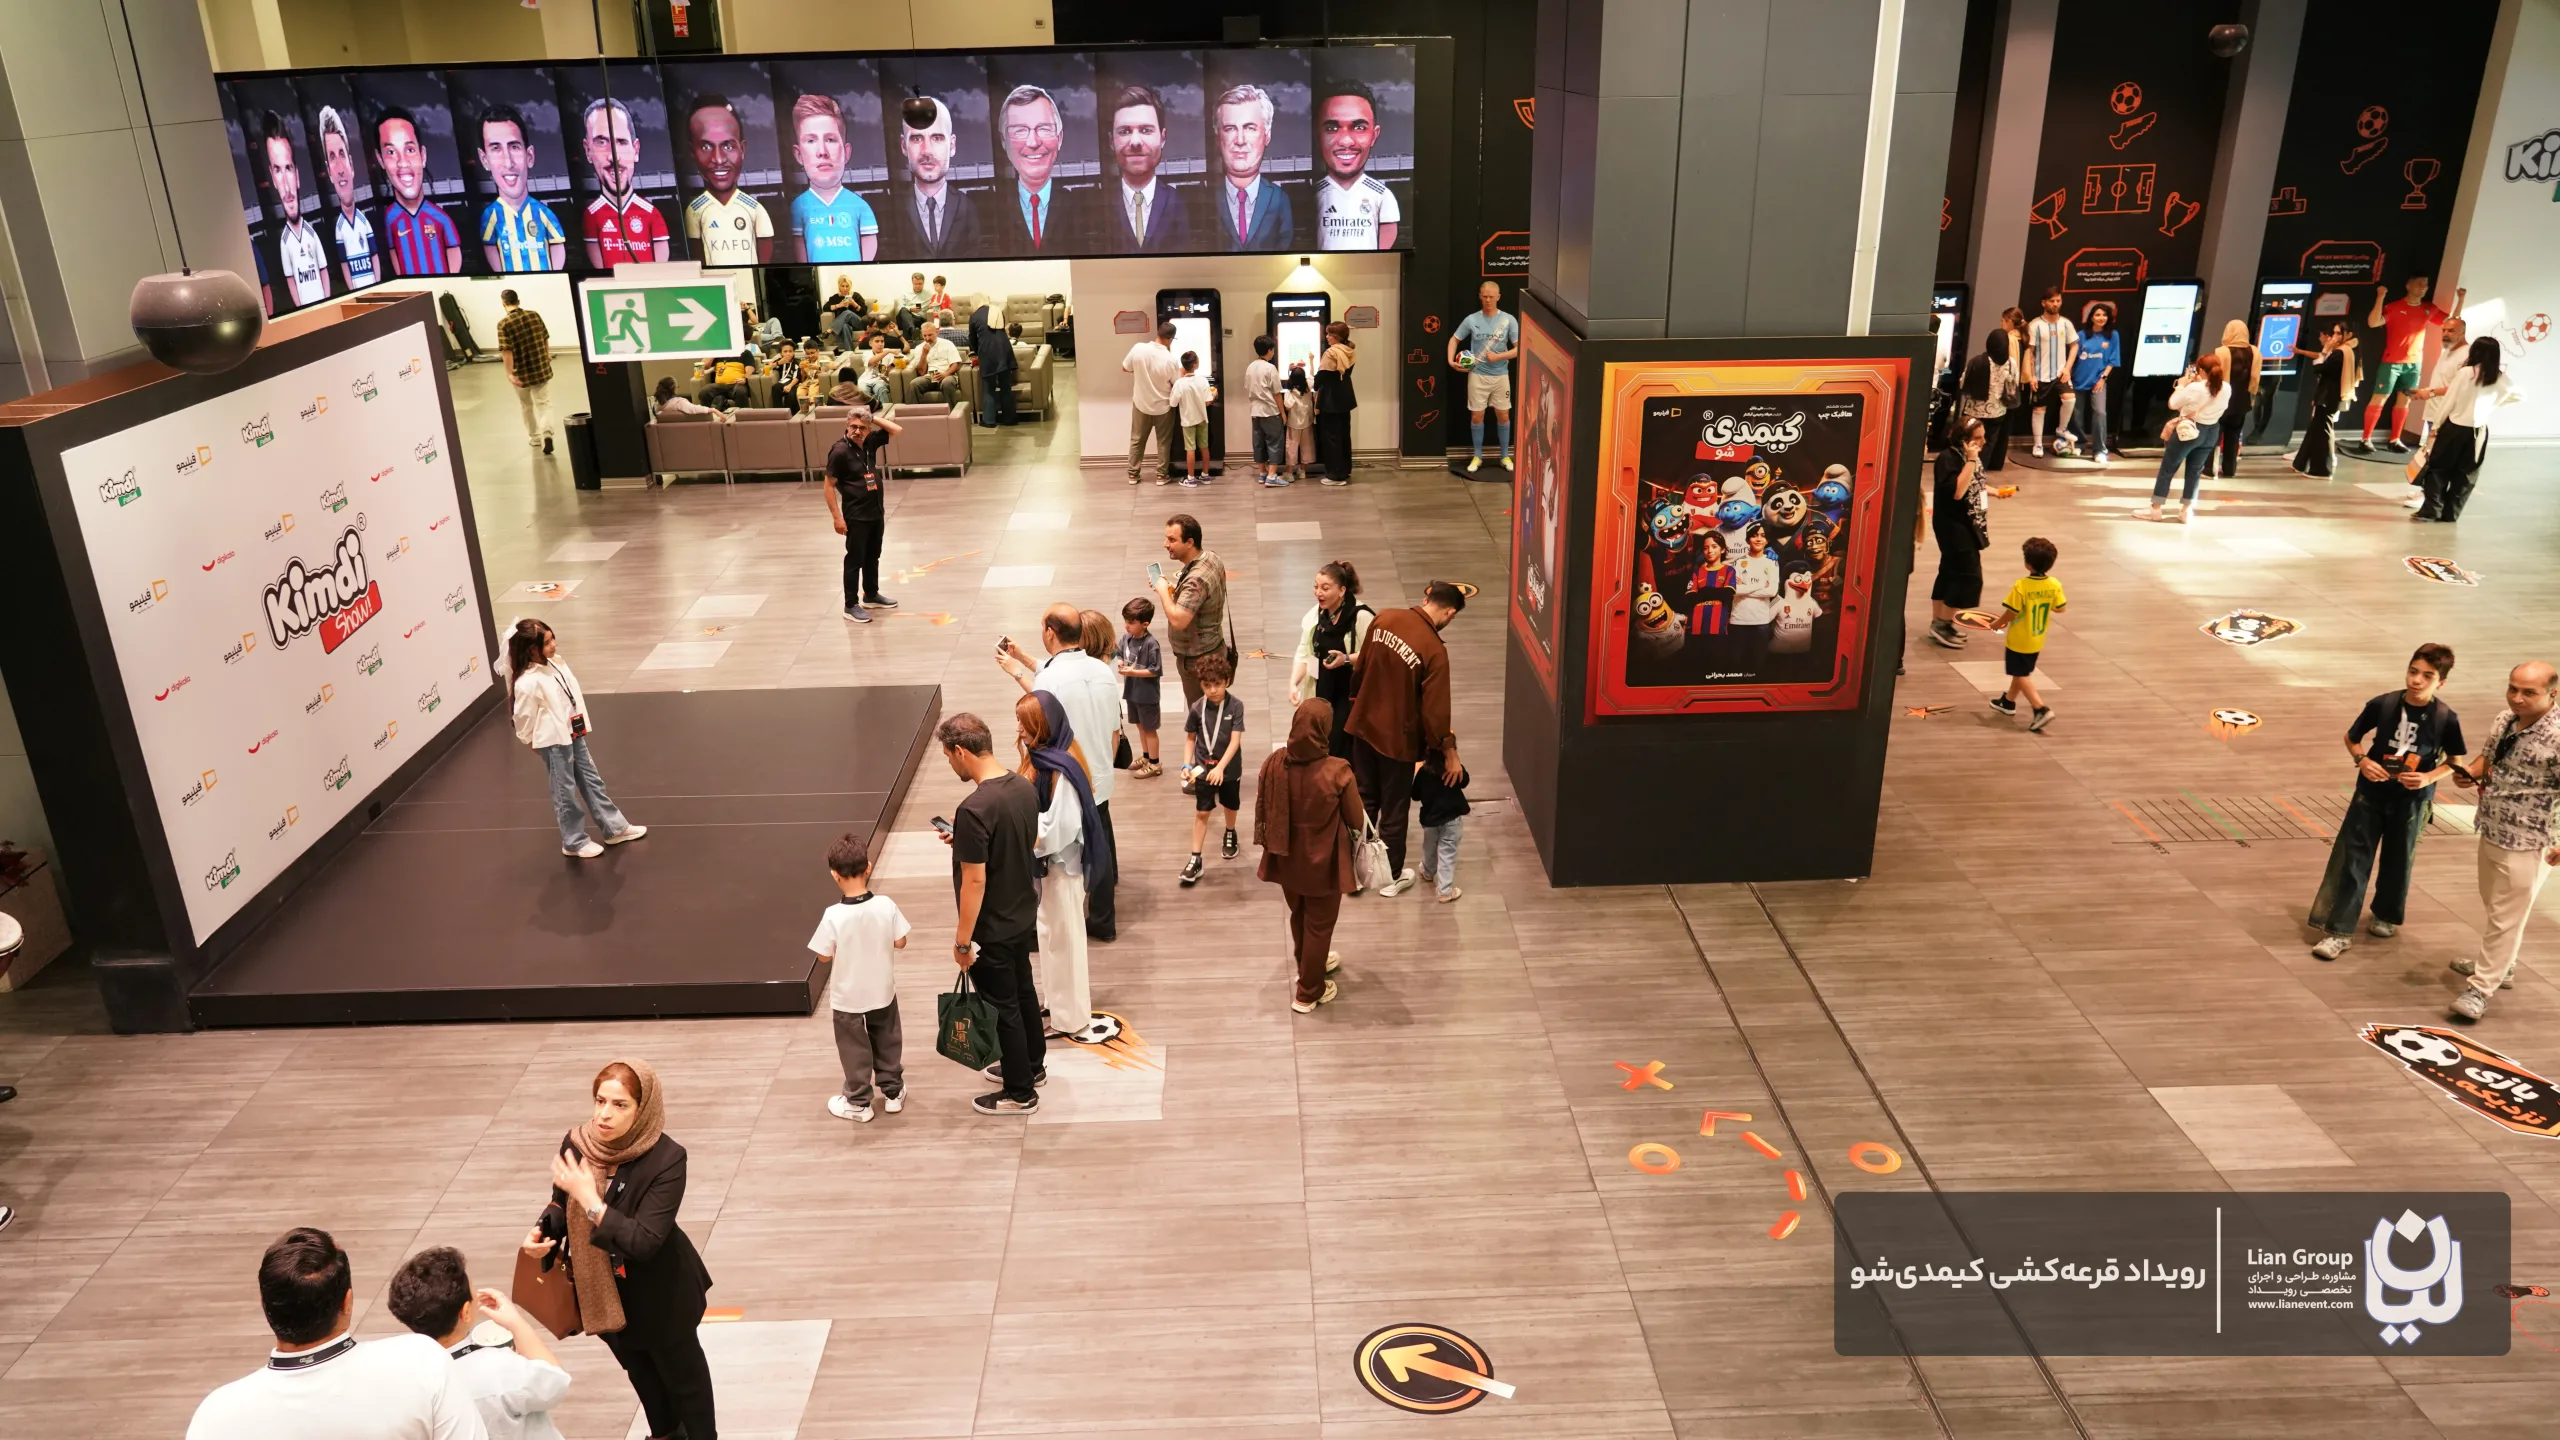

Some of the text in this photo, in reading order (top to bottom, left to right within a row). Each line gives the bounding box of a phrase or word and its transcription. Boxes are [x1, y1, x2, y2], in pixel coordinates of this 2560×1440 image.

[2503, 129, 2560, 183] Ki
[1322, 216, 1372, 228] Emirates
[1330, 228, 1365, 237] FLY BETTER
[826, 235, 852, 247] MSC
[299, 267, 317, 284] bwin
[350, 257, 372, 272] TELUS
[352, 373, 375, 398] Kimdi
[241, 415, 271, 444] Kimdi
[1818, 411, 1830, 420] چپ
[1703, 412, 1805, 453] کیمدی
[1714, 446, 1735, 460] شو
[99, 470, 137, 503] Kimdi
[320, 482, 345, 511] Kimdi
[129, 588, 152, 612] فیلیمو
[262, 526, 369, 649] Kimdi
[335, 595, 373, 640] Show!
[1784, 622, 1811, 630] Emirates
[2031, 602, 2051, 636] 10
[357, 645, 380, 675] Kimdi
[418, 684, 439, 713] Kimdi
[323, 758, 350, 791] Kimdi
[205, 852, 237, 891] Kimdi
[2464, 1067, 2539, 1103] بازی
